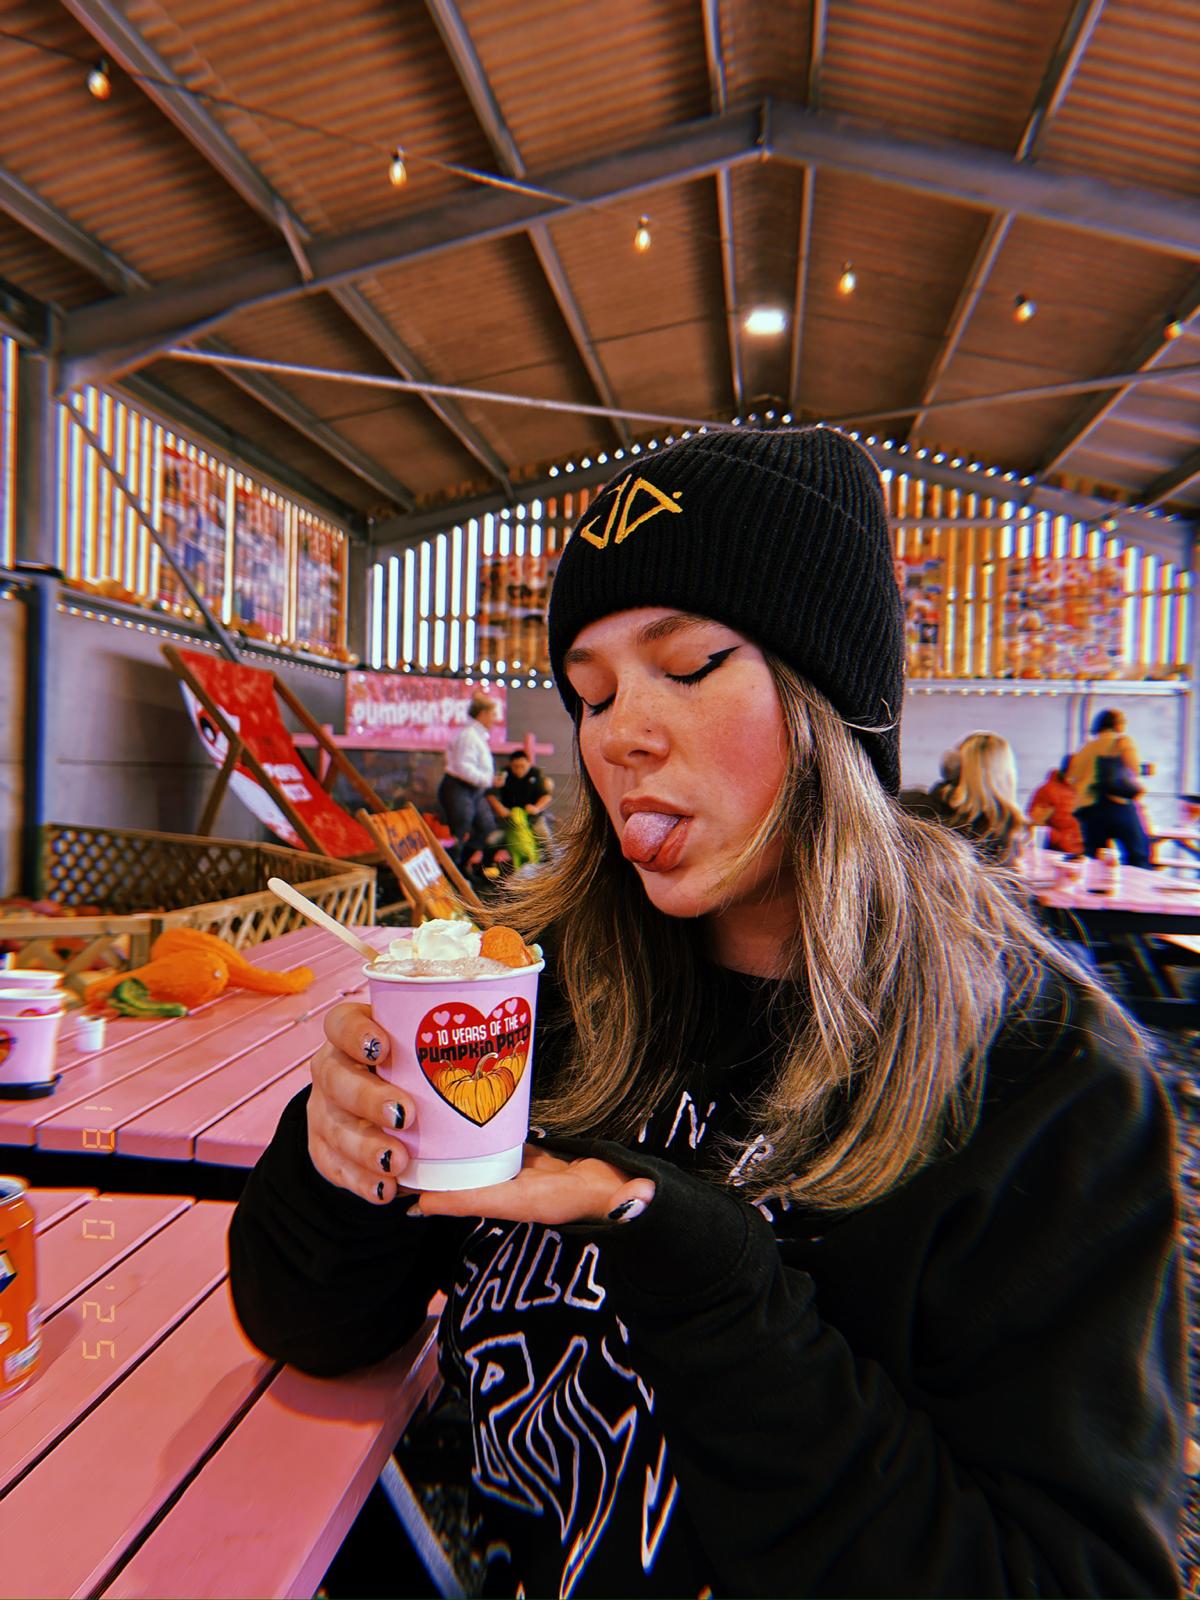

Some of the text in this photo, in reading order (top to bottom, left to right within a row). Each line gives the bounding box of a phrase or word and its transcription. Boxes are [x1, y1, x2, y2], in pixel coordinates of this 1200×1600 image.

[436, 1014, 519, 1046] 10 YEARS OF THE
